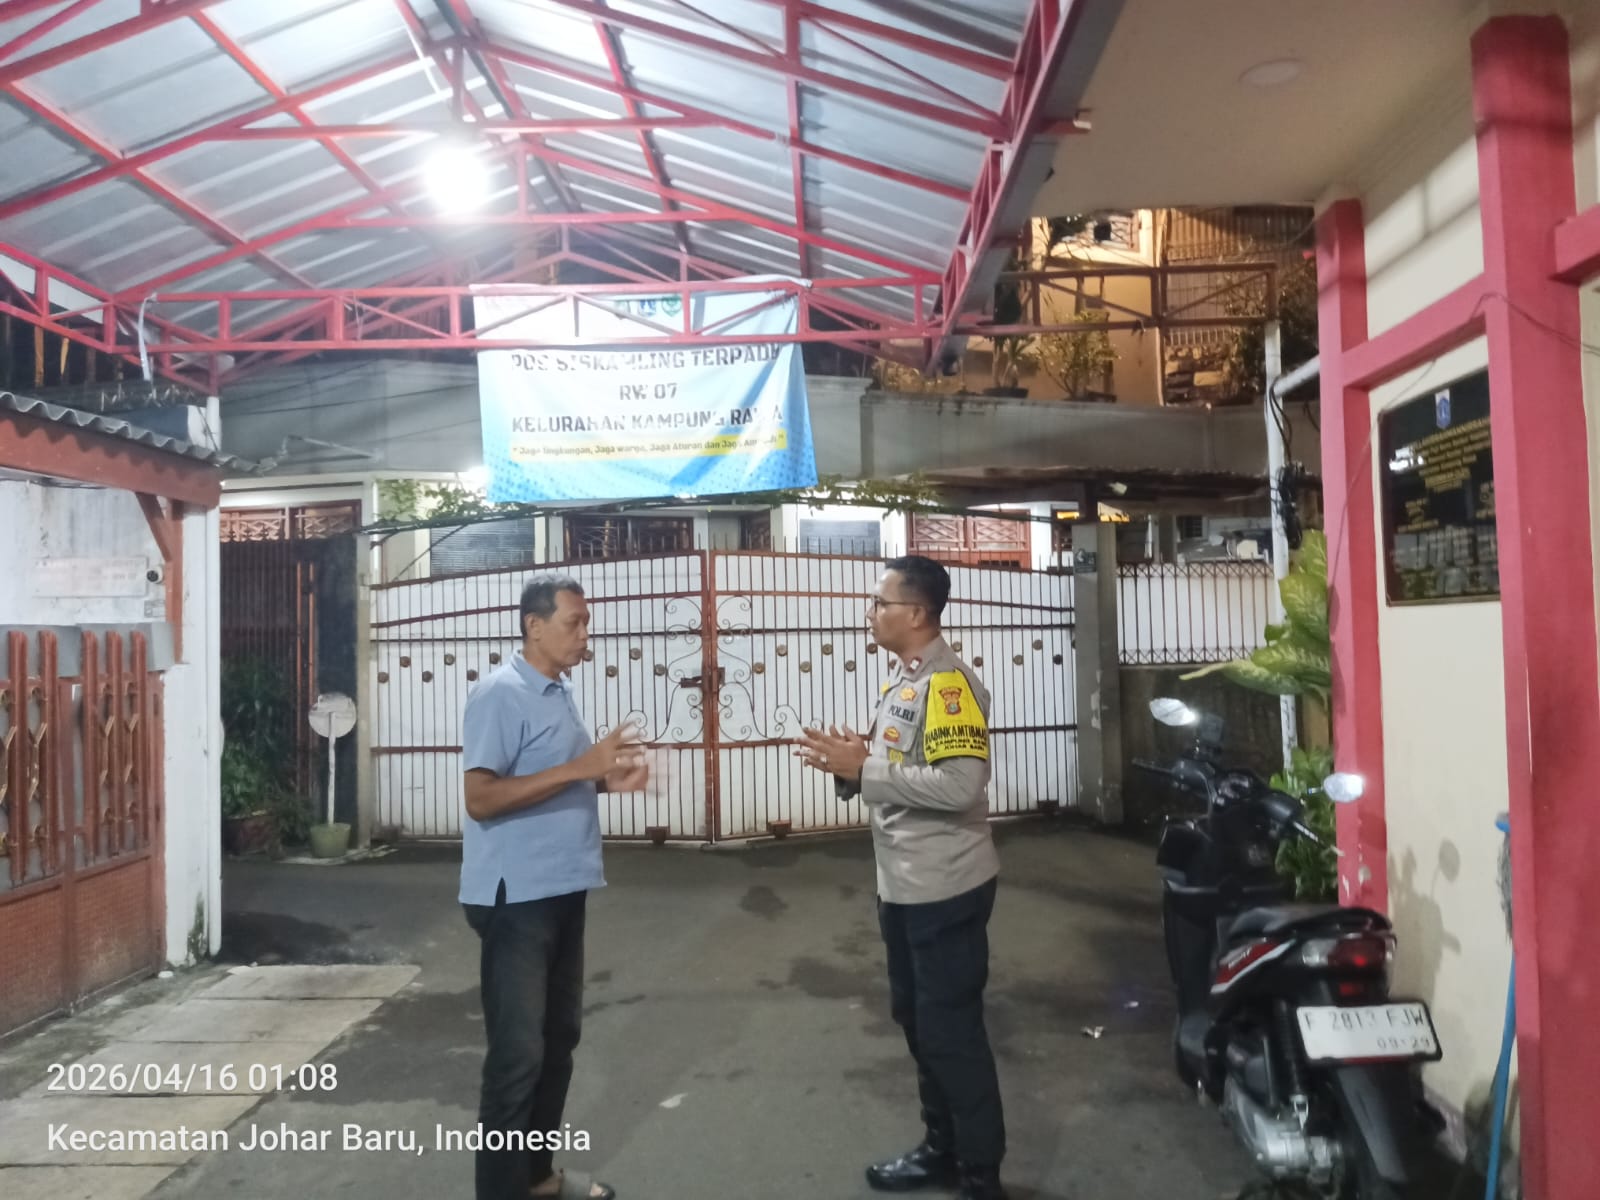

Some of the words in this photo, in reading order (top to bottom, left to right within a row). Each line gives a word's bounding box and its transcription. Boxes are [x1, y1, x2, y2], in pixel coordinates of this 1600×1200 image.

[619, 384, 649, 401] RW
[654, 382, 678, 400] 07
[512, 414, 626, 433] KELURAHAN
[730, 404, 783, 426] RAA
[704, 439, 720, 449] dan
[888, 705, 916, 722] POLRI
